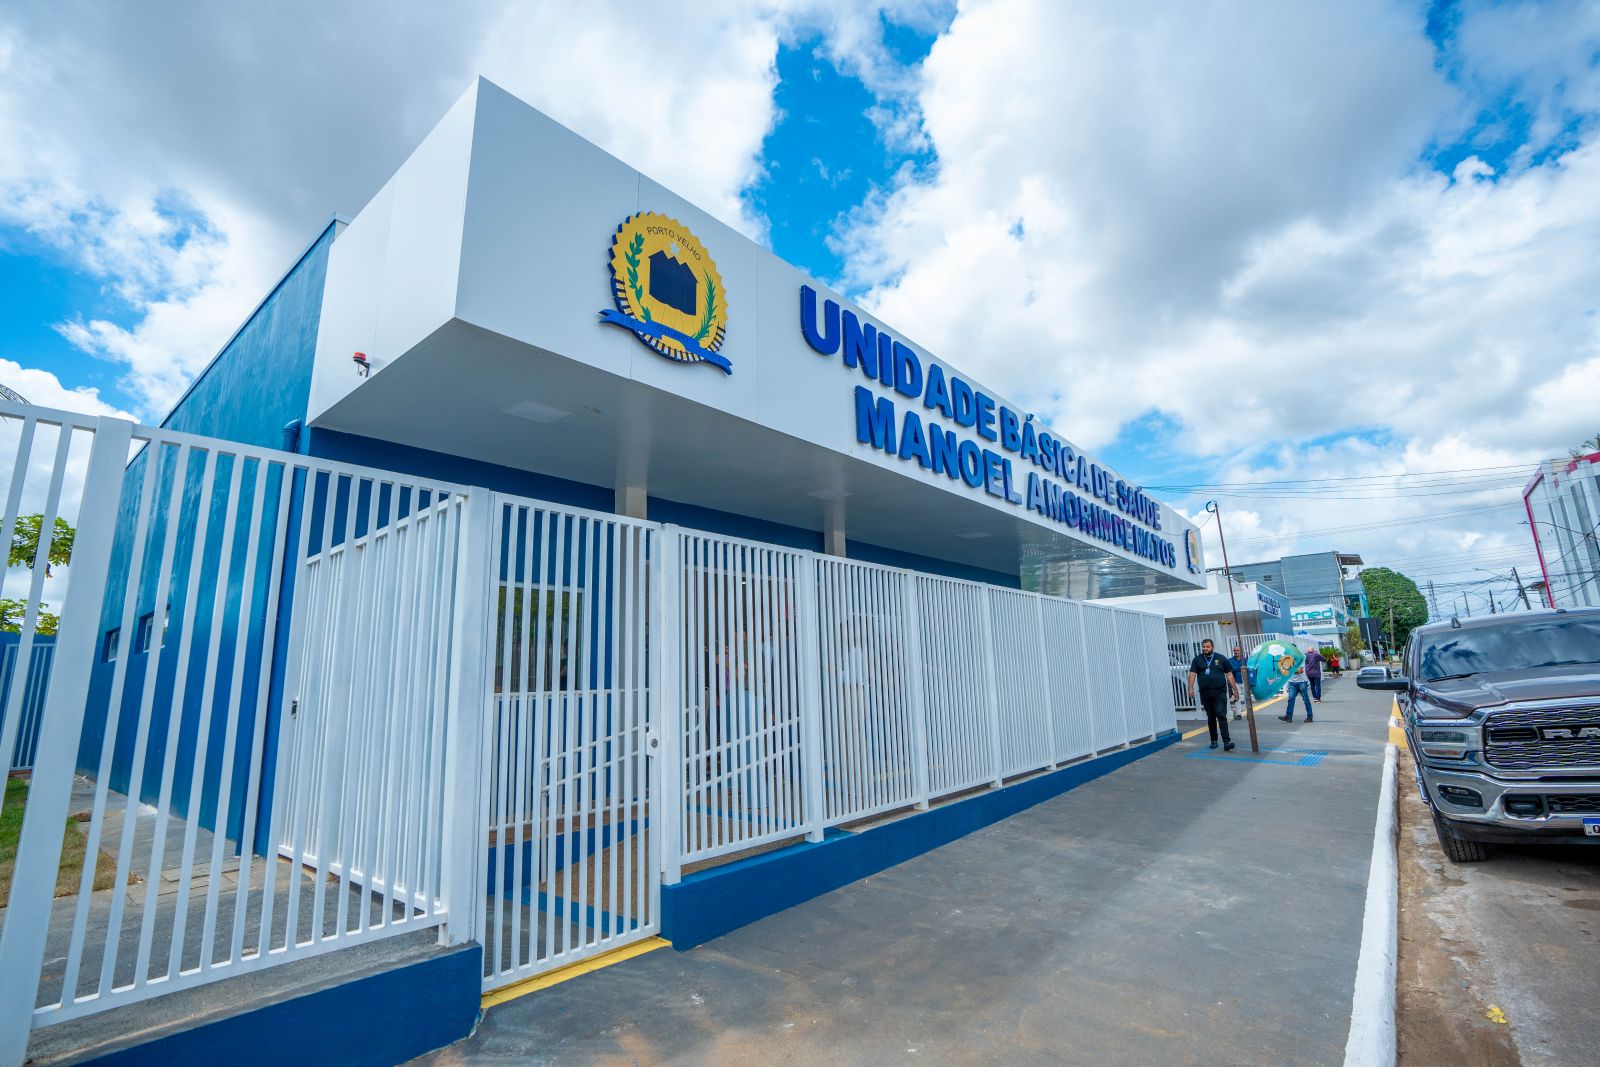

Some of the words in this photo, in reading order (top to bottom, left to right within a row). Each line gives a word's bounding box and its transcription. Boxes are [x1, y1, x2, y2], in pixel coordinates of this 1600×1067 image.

[646, 226, 674, 238] PORTO
[677, 233, 701, 261] VELHO
[800, 284, 997, 442] UNIDADE
[1000, 406, 1092, 493] BÁSICA
[1091, 463, 1116, 505] DE
[1116, 480, 1161, 530] SAÚDE
[855, 386, 1022, 505] MANOEL
[1027, 471, 1112, 542] AMORIM
[1111, 514, 1133, 551] DE
[1132, 524, 1176, 568] MATOS
